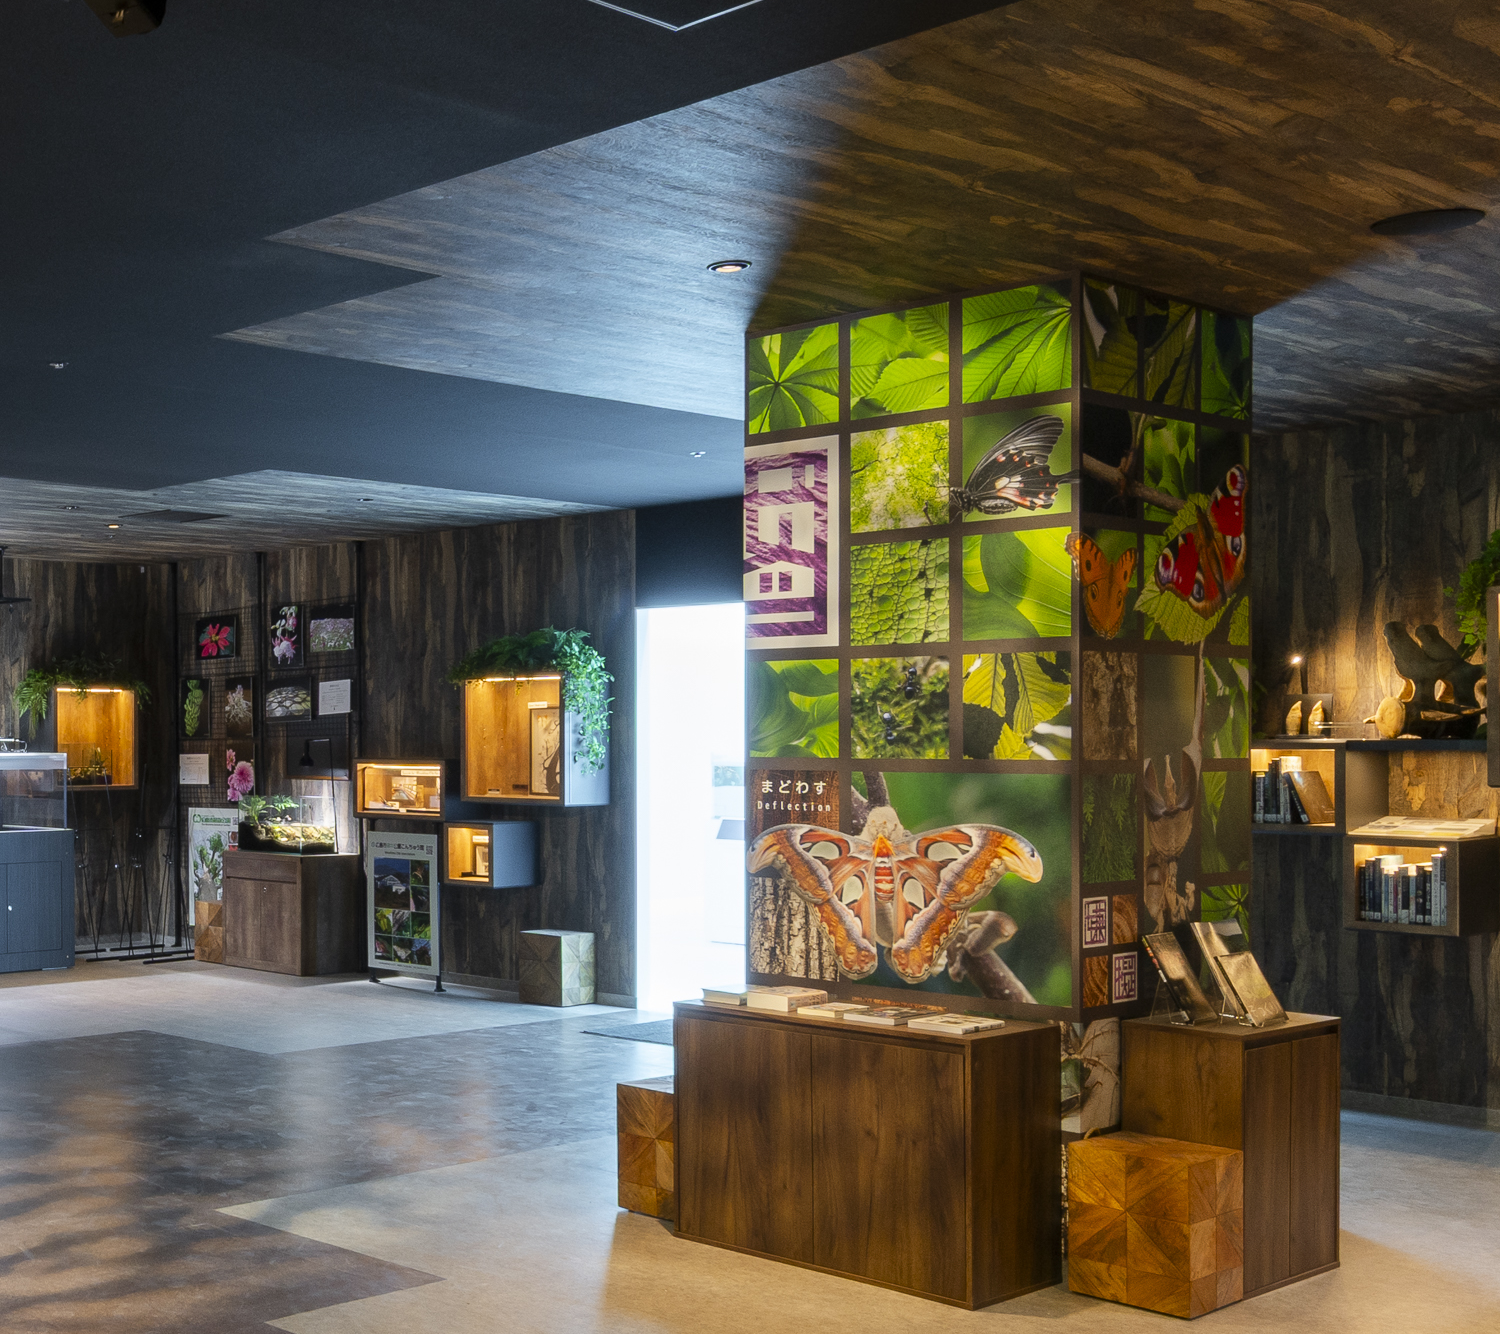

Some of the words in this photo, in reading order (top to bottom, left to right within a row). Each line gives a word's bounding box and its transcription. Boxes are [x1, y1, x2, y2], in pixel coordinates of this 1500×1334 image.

[761, 779, 827, 795] まどわす
[757, 800, 831, 812] Deflection
